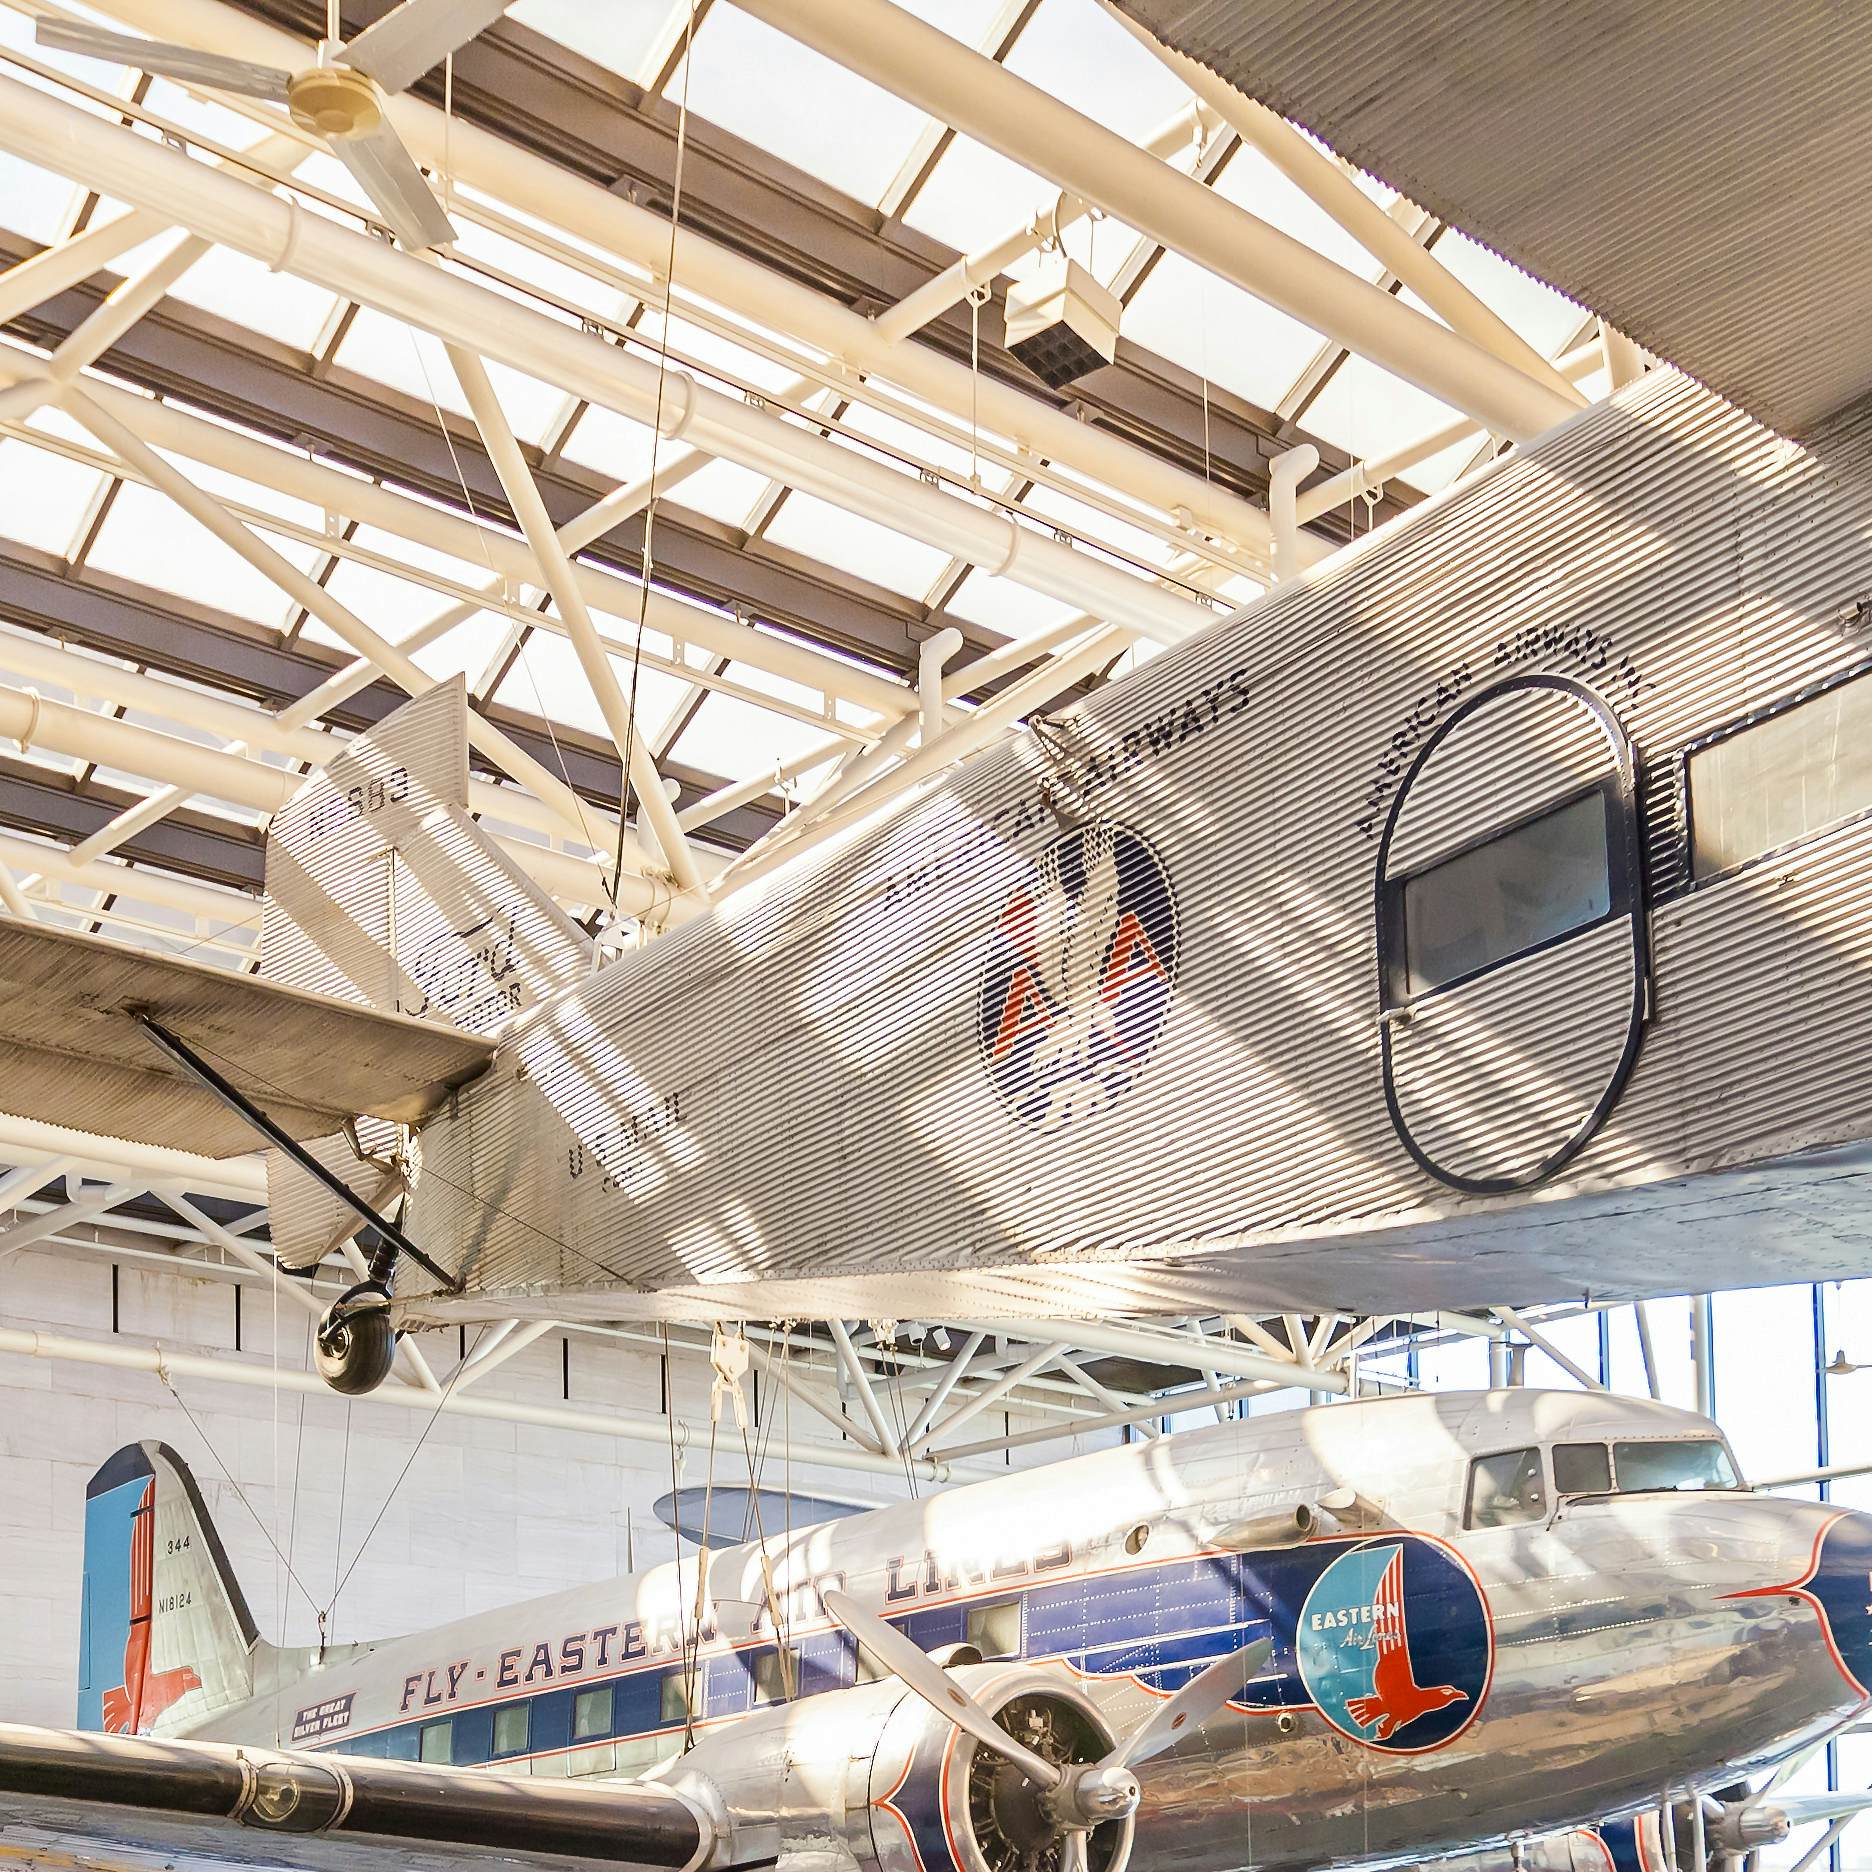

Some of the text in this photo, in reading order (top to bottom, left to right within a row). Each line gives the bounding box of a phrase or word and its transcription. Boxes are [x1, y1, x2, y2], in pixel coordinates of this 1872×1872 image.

[167, 1535, 191, 1555] 344
[159, 1591, 192, 1614] N18124
[1311, 1601, 1400, 1631] EASTERN
[399, 1657, 469, 1714] FLY
[302, 1698, 346, 1722] THE GREAT
[293, 1711, 350, 1740] SILVER FLEET
